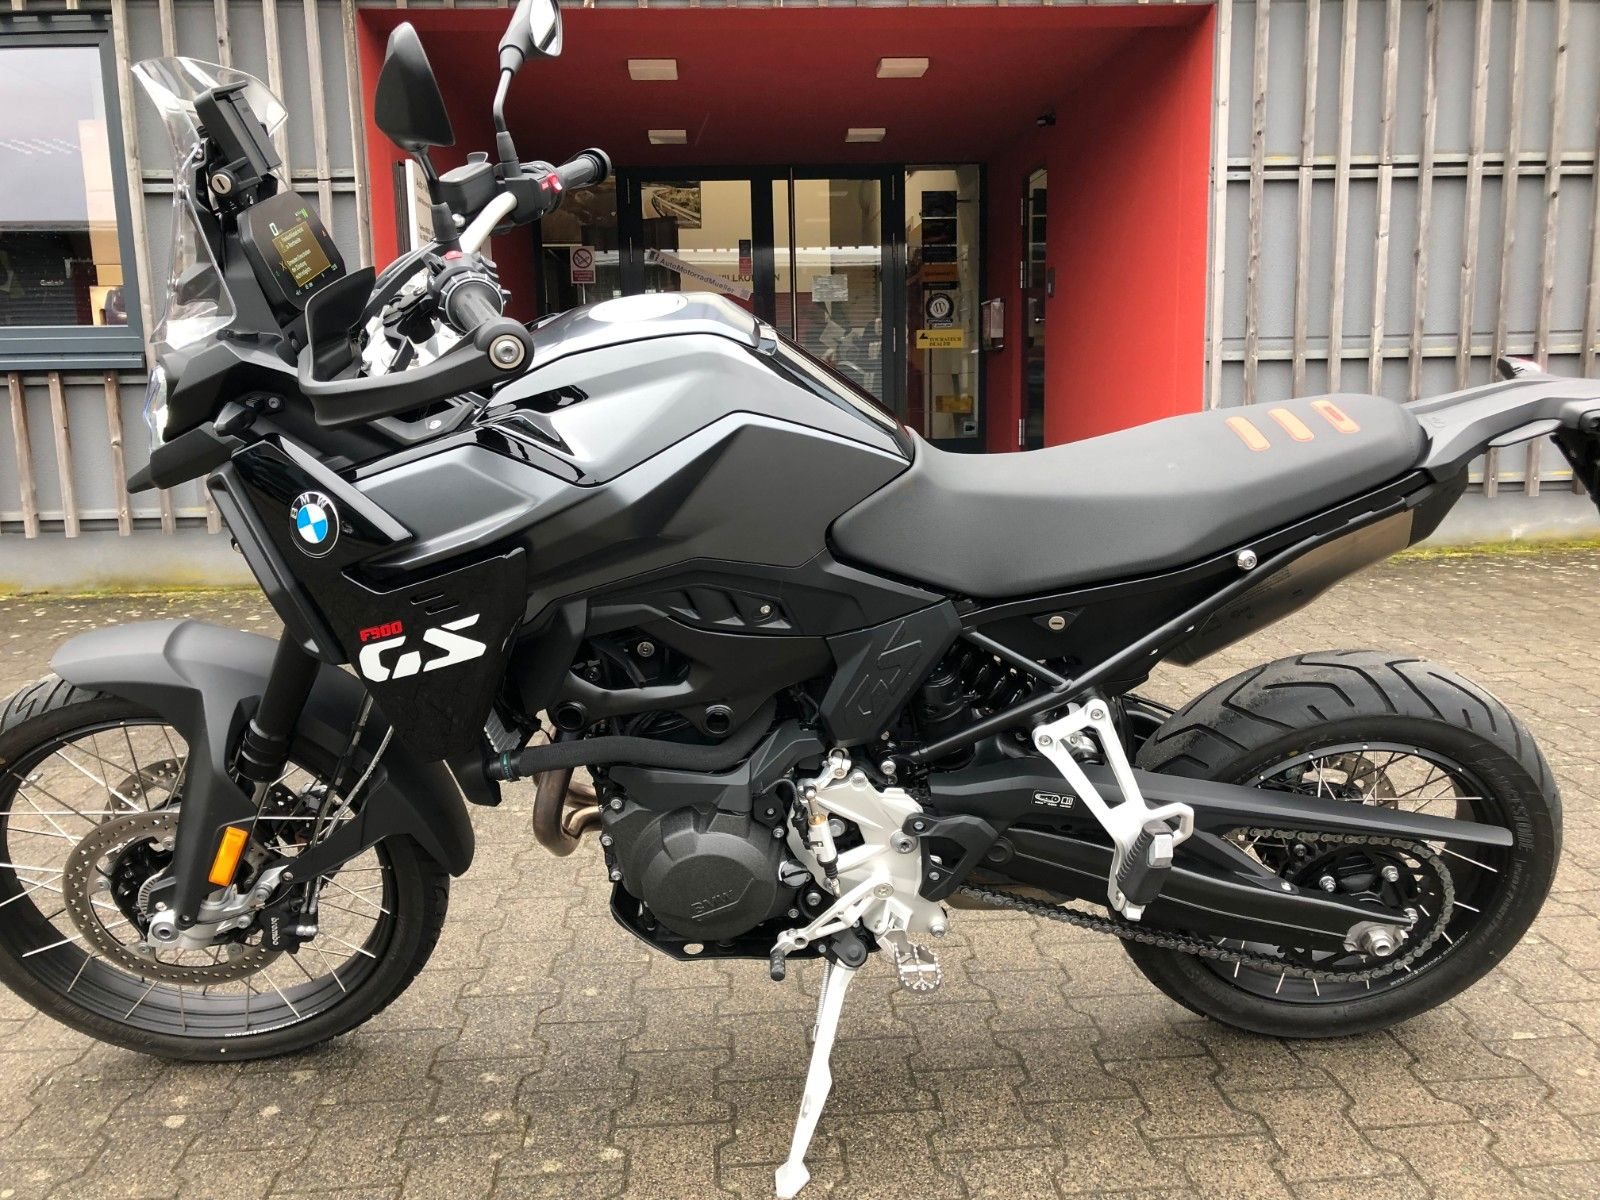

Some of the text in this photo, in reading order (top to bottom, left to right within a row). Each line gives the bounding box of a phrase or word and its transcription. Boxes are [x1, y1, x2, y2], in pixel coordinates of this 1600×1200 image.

[289, 492, 329, 520] BMW
[360, 620, 403, 642] F900
[359, 613, 487, 683] GS
